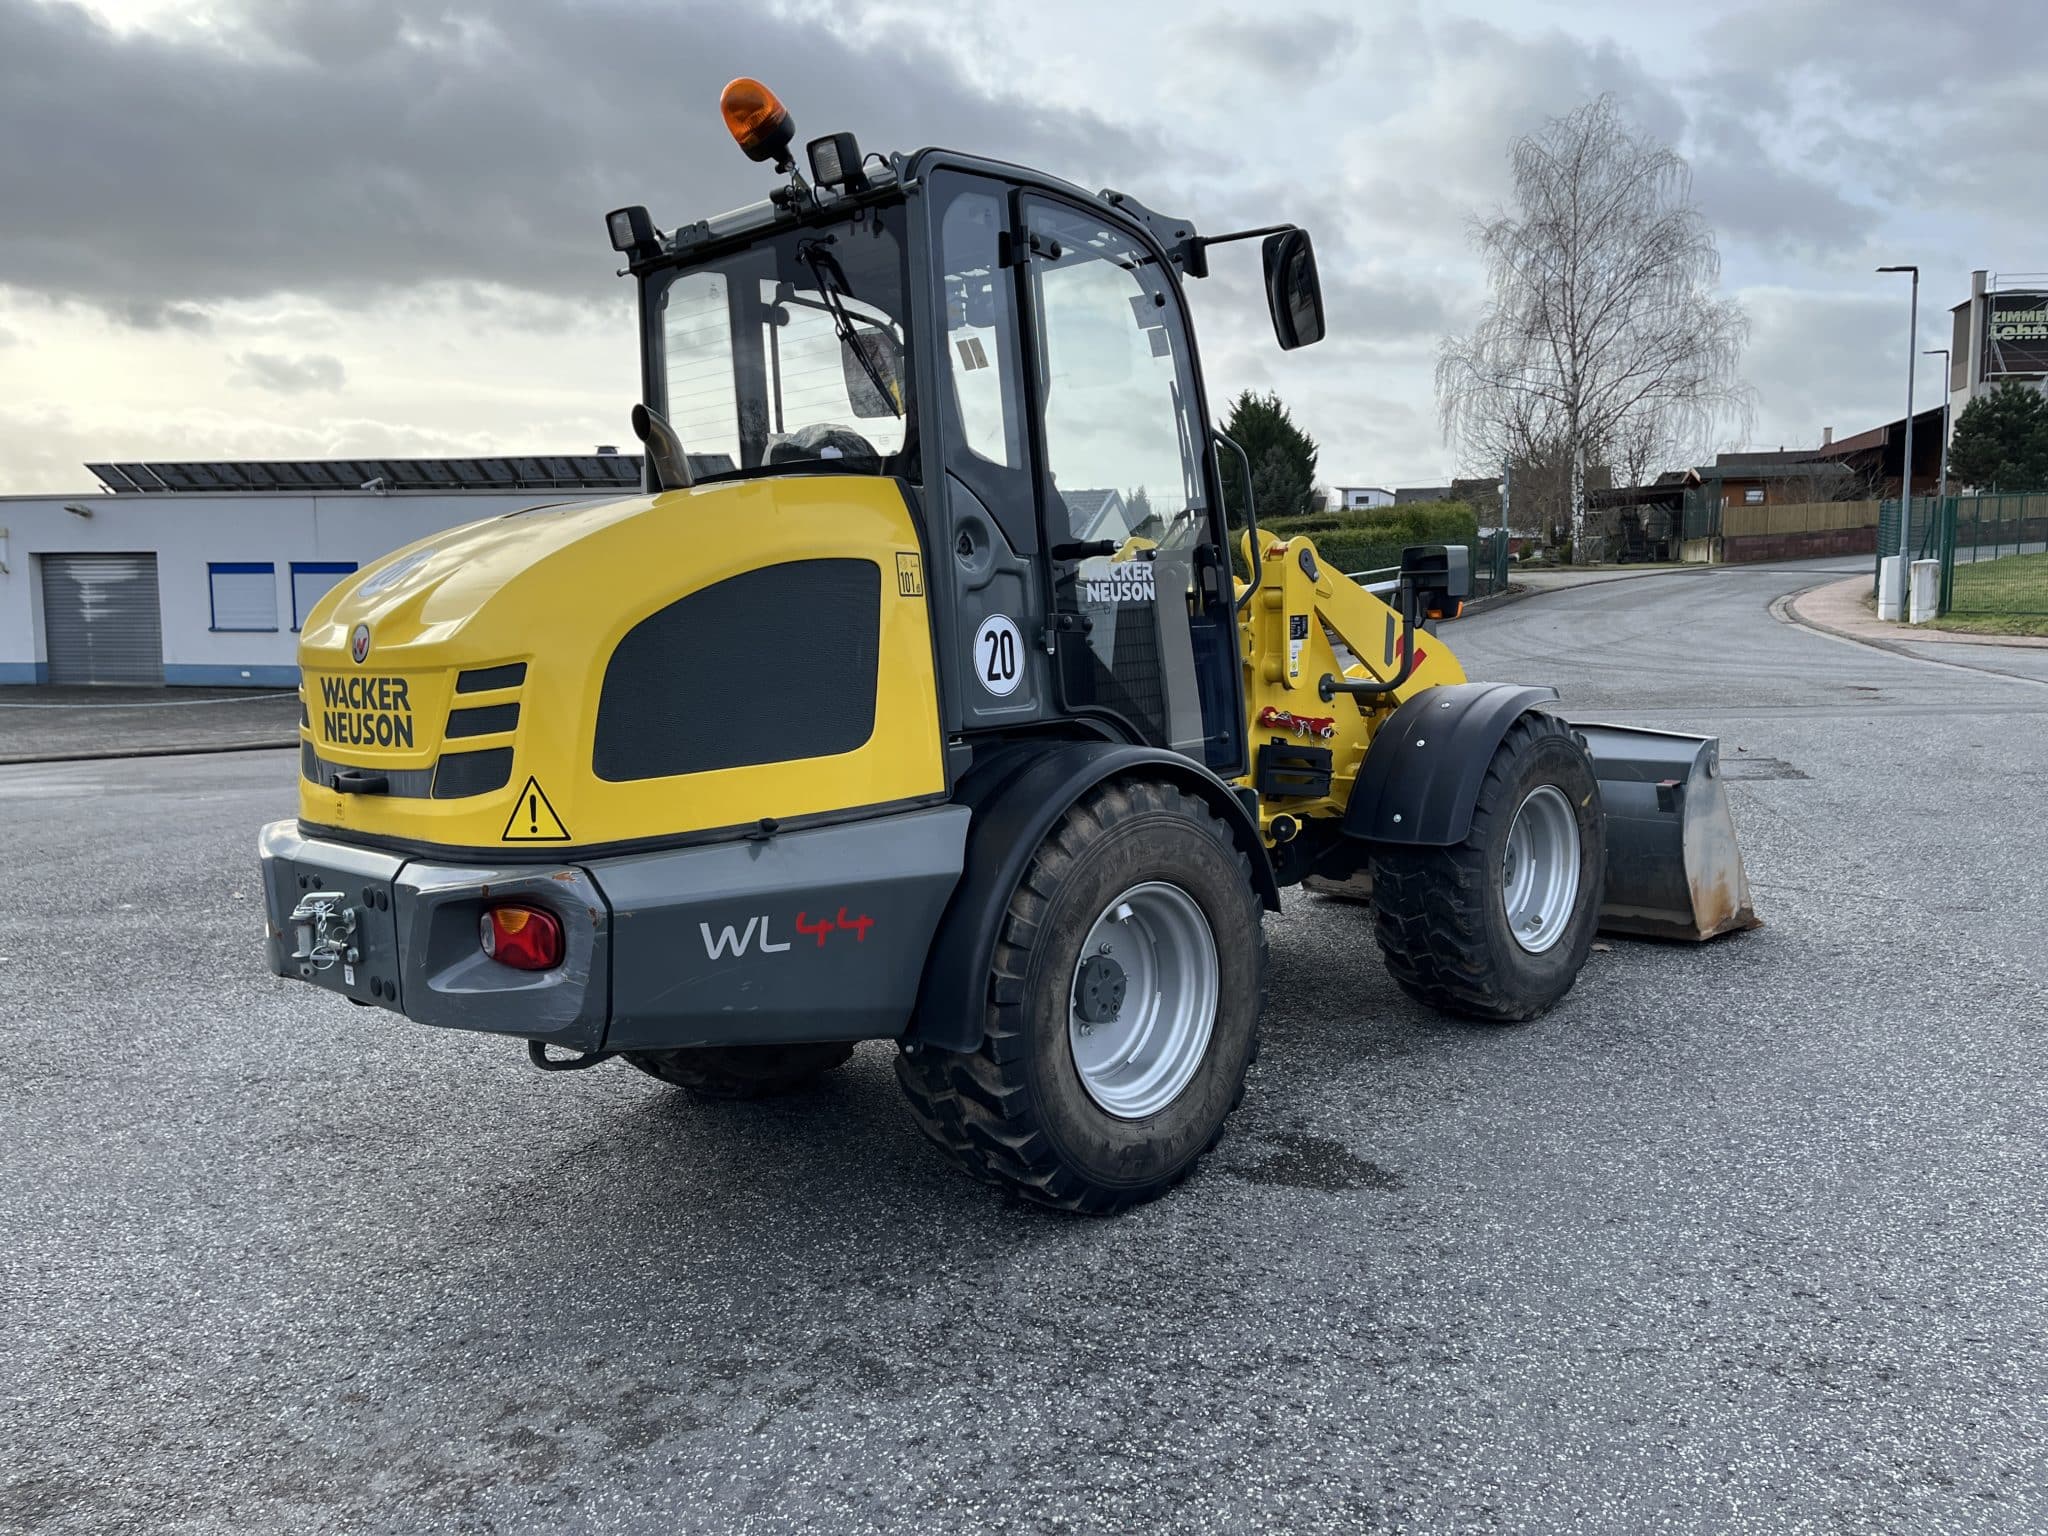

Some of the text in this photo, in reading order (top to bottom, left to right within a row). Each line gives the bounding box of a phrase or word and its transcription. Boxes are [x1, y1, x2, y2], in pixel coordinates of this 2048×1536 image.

[1993, 310, 2048, 322] ZIMME
[900, 571, 915, 593] 101
[1087, 561, 1155, 582] CKER
[1087, 581, 1156, 602] NEUSON
[984, 629, 1016, 682] 20
[320, 677, 412, 712] WACKER
[323, 711, 414, 748] NEUSON
[699, 907, 875, 960] WL 44
